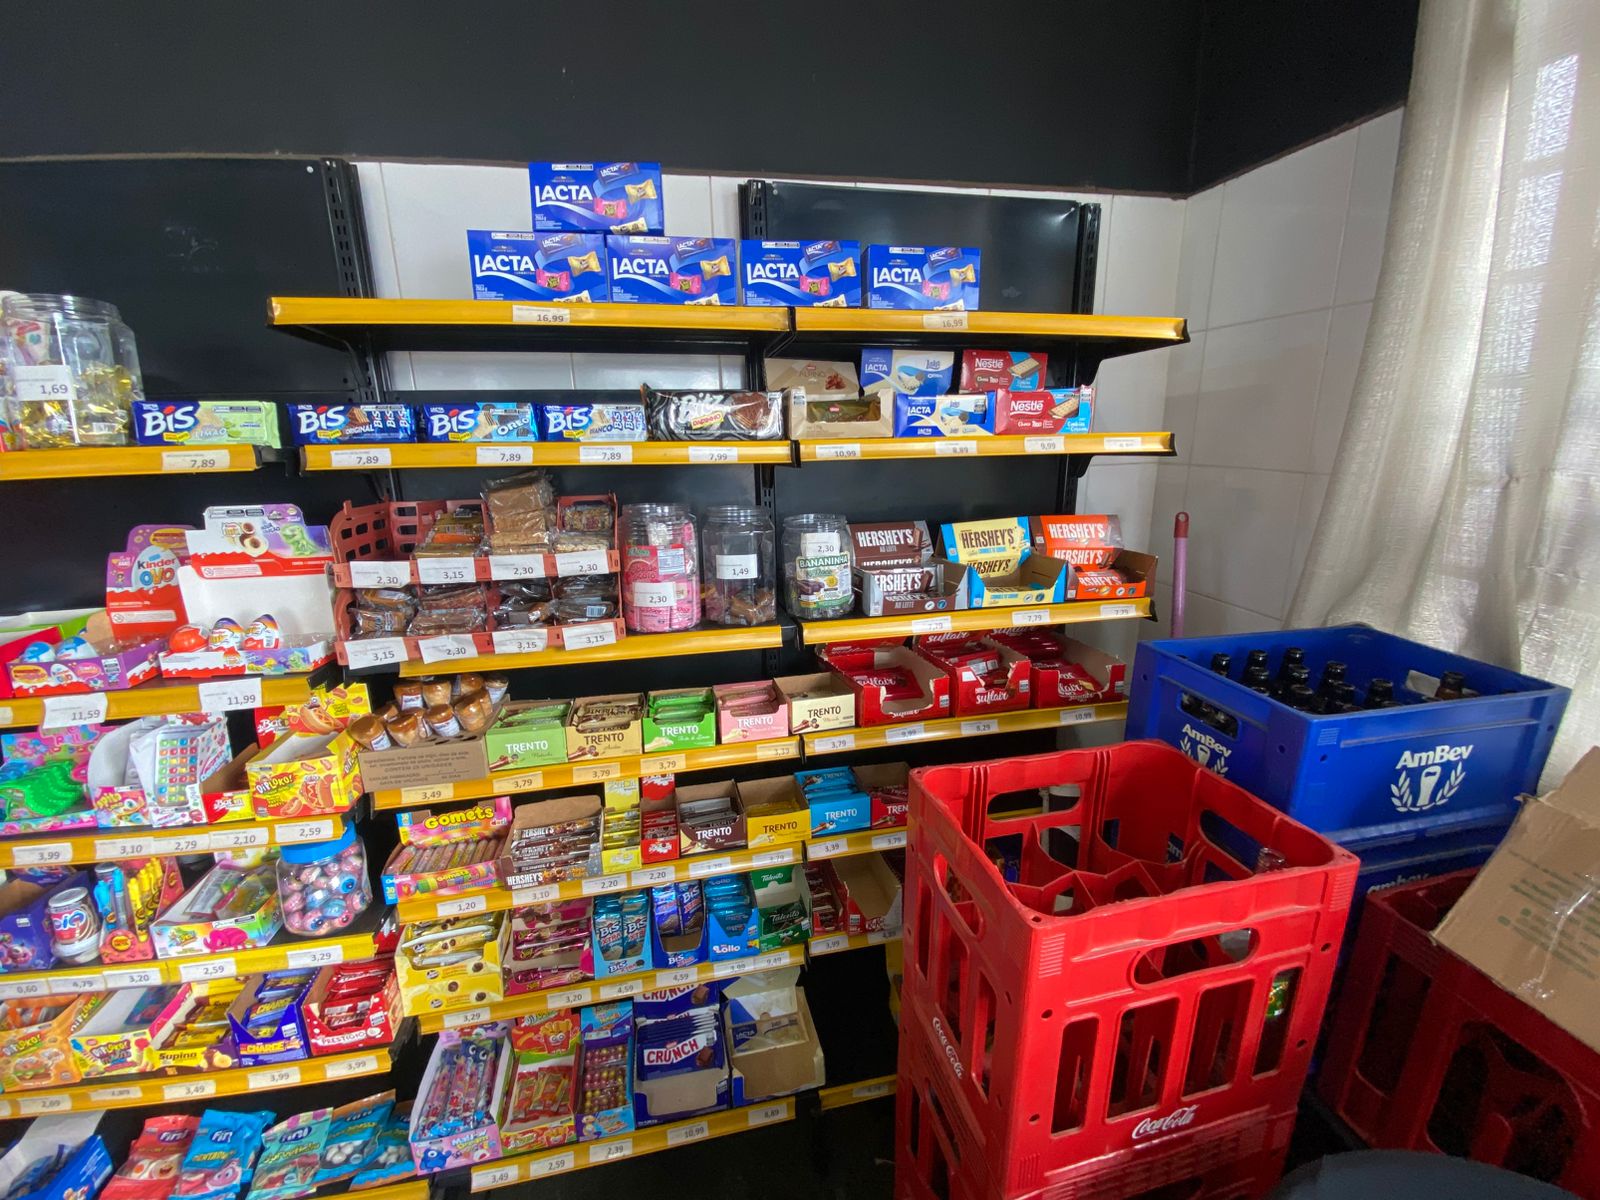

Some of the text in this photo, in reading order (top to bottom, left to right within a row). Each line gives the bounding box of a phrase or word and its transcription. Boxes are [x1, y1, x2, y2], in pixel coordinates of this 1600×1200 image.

[535, 185, 593, 207] LACTA
[474, 255, 535, 277] LACTA
[612, 258, 669, 279] LACTA
[747, 263, 799, 284] LACTA
[874, 267, 922, 287] LACTA
[536, 313, 565, 324] 16,99
[943, 319, 963, 329] 16,99
[865, 363, 888, 373] LACTA
[40, 384, 68, 397] 1,69
[908, 406, 931, 417] LACTA
[345, 425, 375, 437] ORIGINAL
[496, 416, 530, 435] OREO
[1040, 442, 1056, 451] 9,99
[356, 455, 379, 465] 7,89
[500, 452, 521, 462] 7,89
[602, 452, 622, 461] 7,89
[710, 452, 728, 462] 7,99
[835, 450, 857, 459] 10,99
[190, 459, 215, 469] 7,89
[1048, 523, 1105, 539] HERSHEY'S
[857, 530, 913, 547] HERSHEY'S
[961, 528, 1014, 549] HERSHEY'S
[817, 545, 834, 554] 2,30
[579, 562, 598, 573] 2,30
[799, 555, 849, 569] BANANINHA
[443, 570, 464, 581] 3,15
[513, 566, 534, 576] 2,30
[732, 566, 749, 576] 1,49
[376, 575, 399, 586] 2,30
[649, 595, 667, 604] 2,30
[1027, 614, 1042, 623] 7,79
[585, 633, 605, 644] 3,15
[517, 640, 537, 650] 3,15
[372, 649, 395, 662] 3,15
[446, 645, 466, 657] 2,30
[227, 693, 256, 706] 11,99
[72, 709, 100, 722] 11,59
[807, 705, 842, 719] TRENTO
[738, 715, 774, 728] TRENTO
[660, 724, 699, 738] TRENTO
[583, 732, 625, 746] TRENTO
[831, 739, 847, 749] 3,79
[1181, 723, 1232, 758] AmBev
[505, 740, 549, 755] TRENTO
[1395, 745, 1474, 770] AmBev
[658, 760, 677, 769] 3,79
[592, 768, 611, 779] 3,79
[513, 778, 534, 789] 3,79
[422, 790, 442, 801] 3,49
[824, 807, 858, 820] TRENTO
[886, 804, 909, 815] TREN
[299, 826, 321, 838] 2,59
[762, 821, 798, 834] TRENTO
[695, 826, 732, 841] TRENTO
[174, 839, 197, 851] 2,79
[233, 834, 256, 846] 2,10
[119, 843, 143, 855] 3,10
[38, 850, 60, 862] 3,99
[506, 872, 543, 887] HERSHEY'S
[649, 871, 667, 880] 2,20
[600, 879, 618, 890] 2,20
[532, 890, 550, 900] 3,10
[457, 901, 477, 912] 1,20
[311, 951, 332, 962] 3,29
[203, 964, 225, 976] 2,59
[129, 973, 150, 984] 3,20
[673, 972, 689, 982] 4,59
[617, 984, 634, 994] 4,59
[565, 993, 583, 1003] 3,20
[463, 1012, 481, 1022] 3,29
[158, 1051, 197, 1062] Supino
[646, 1038, 699, 1065] CRUNCH
[346, 1060, 367, 1071] 3,99
[270, 1072, 290, 1082] 3,99
[185, 1084, 205, 1095] 3,49
[548, 1159, 566, 1171] 2,59
[491, 1172, 509, 1183] 3,49
